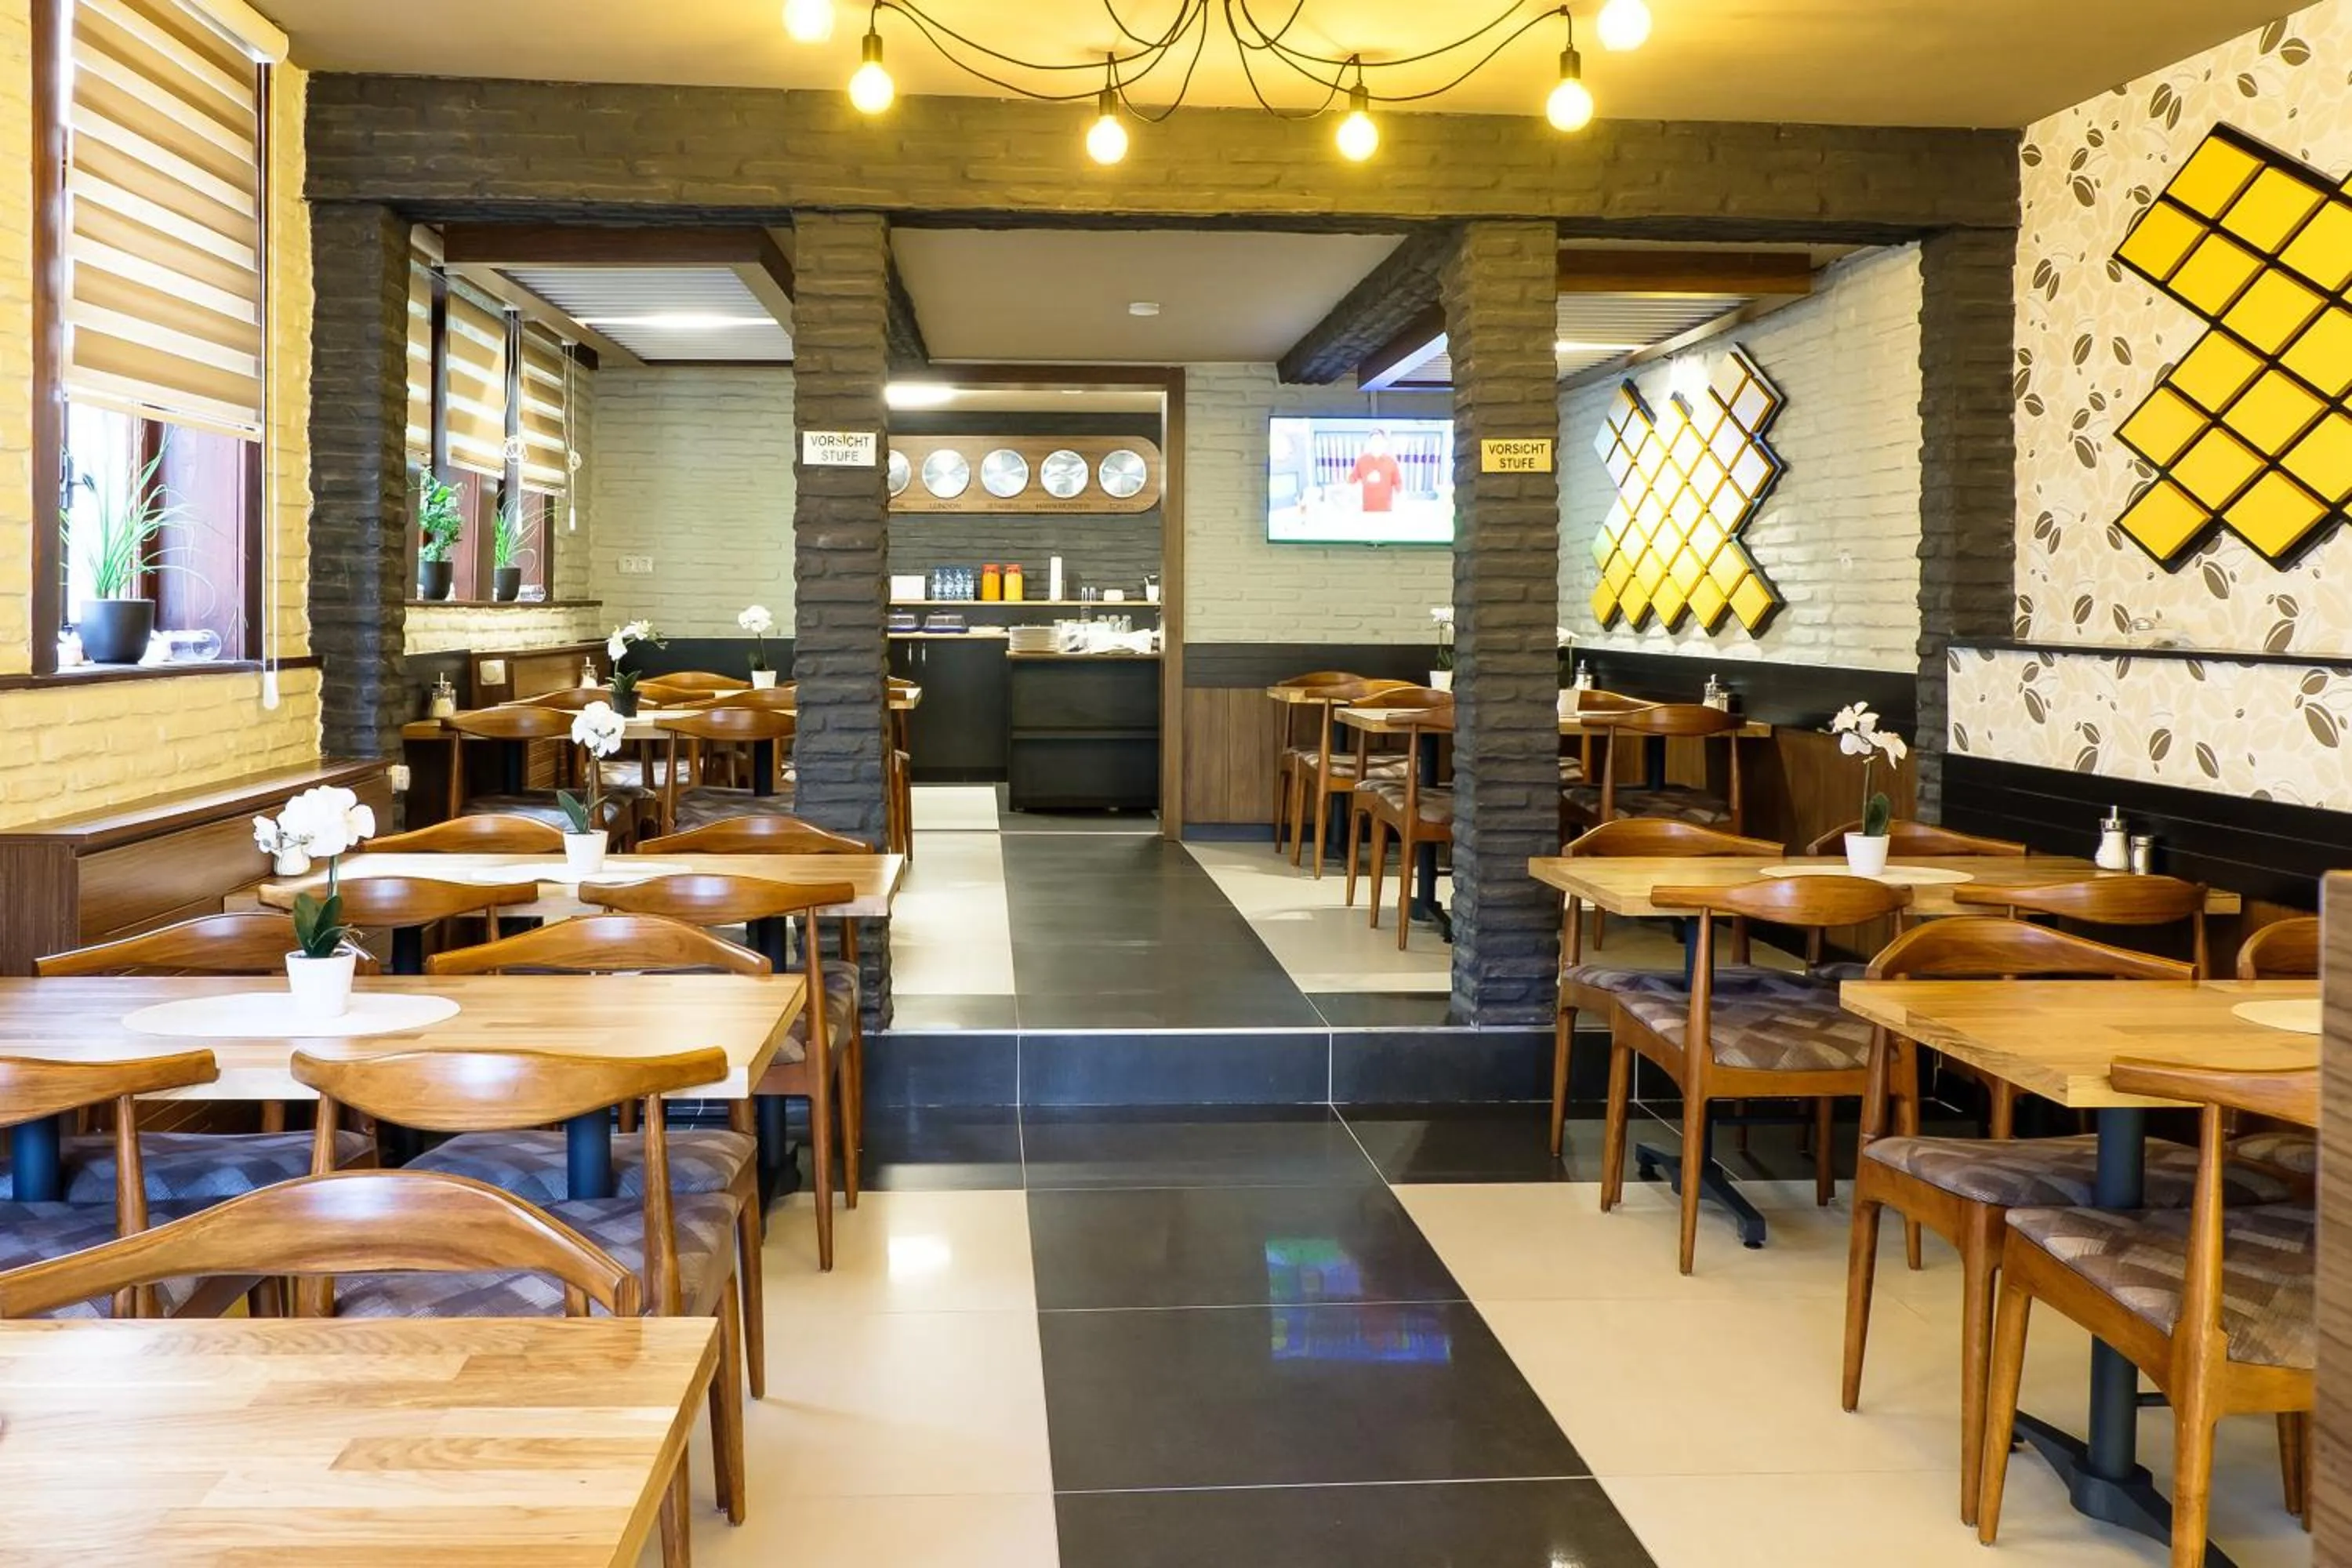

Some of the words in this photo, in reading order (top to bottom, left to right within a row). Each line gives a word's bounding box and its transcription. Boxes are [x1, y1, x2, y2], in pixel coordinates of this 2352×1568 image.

[810, 434, 869, 448] VORSICHT
[1488, 442, 1546, 455] VORSICHT
[821, 449, 858, 462] STUFE
[1499, 457, 1534, 469] STUFE
